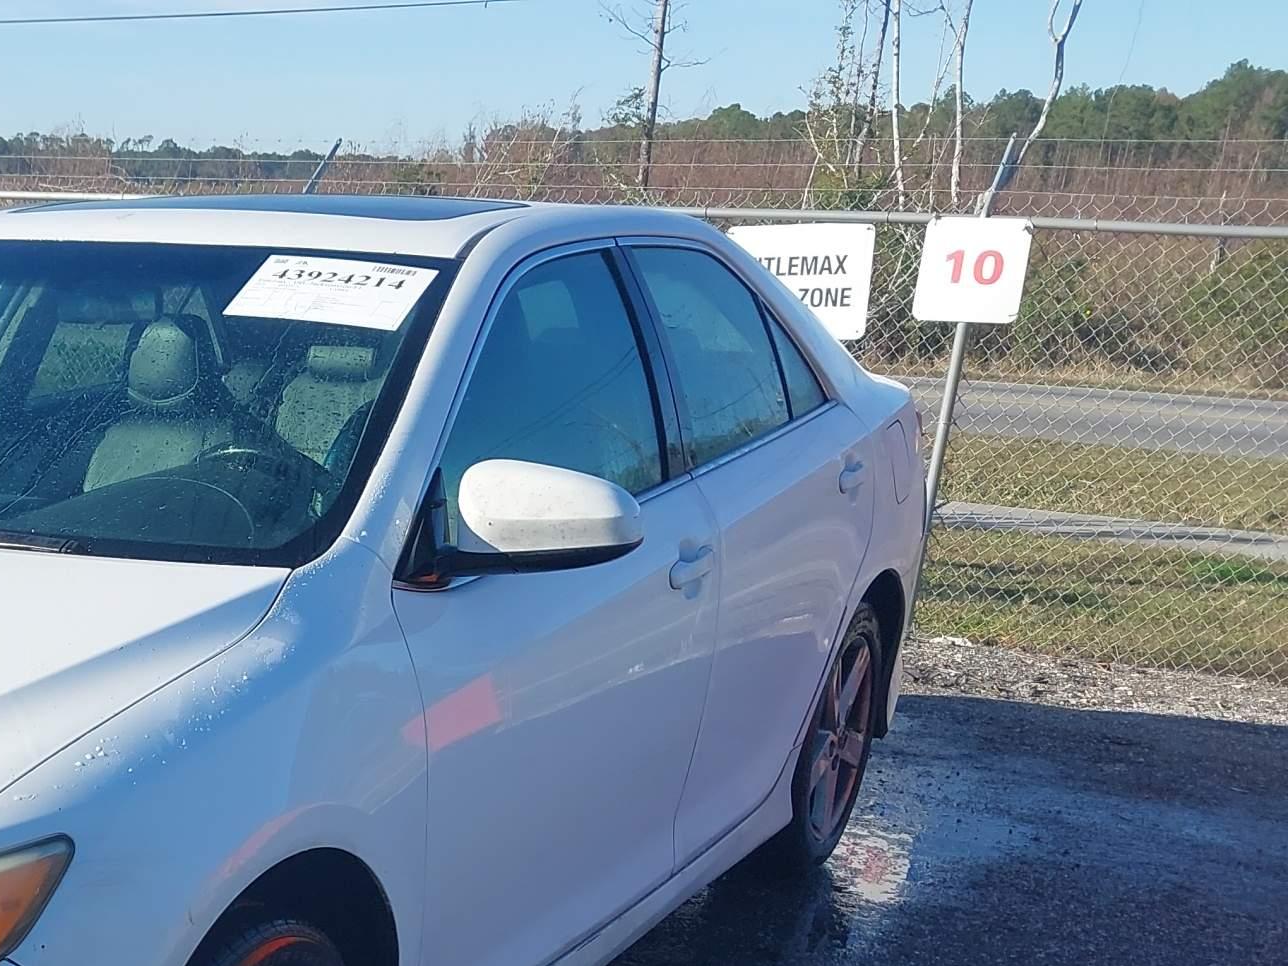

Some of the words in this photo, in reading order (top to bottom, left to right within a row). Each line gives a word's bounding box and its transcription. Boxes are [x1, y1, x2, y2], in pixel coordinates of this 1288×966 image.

[272, 267, 407, 290] 43924214
[945, 249, 1005, 286] 10
[798, 287, 853, 308] ZONE
